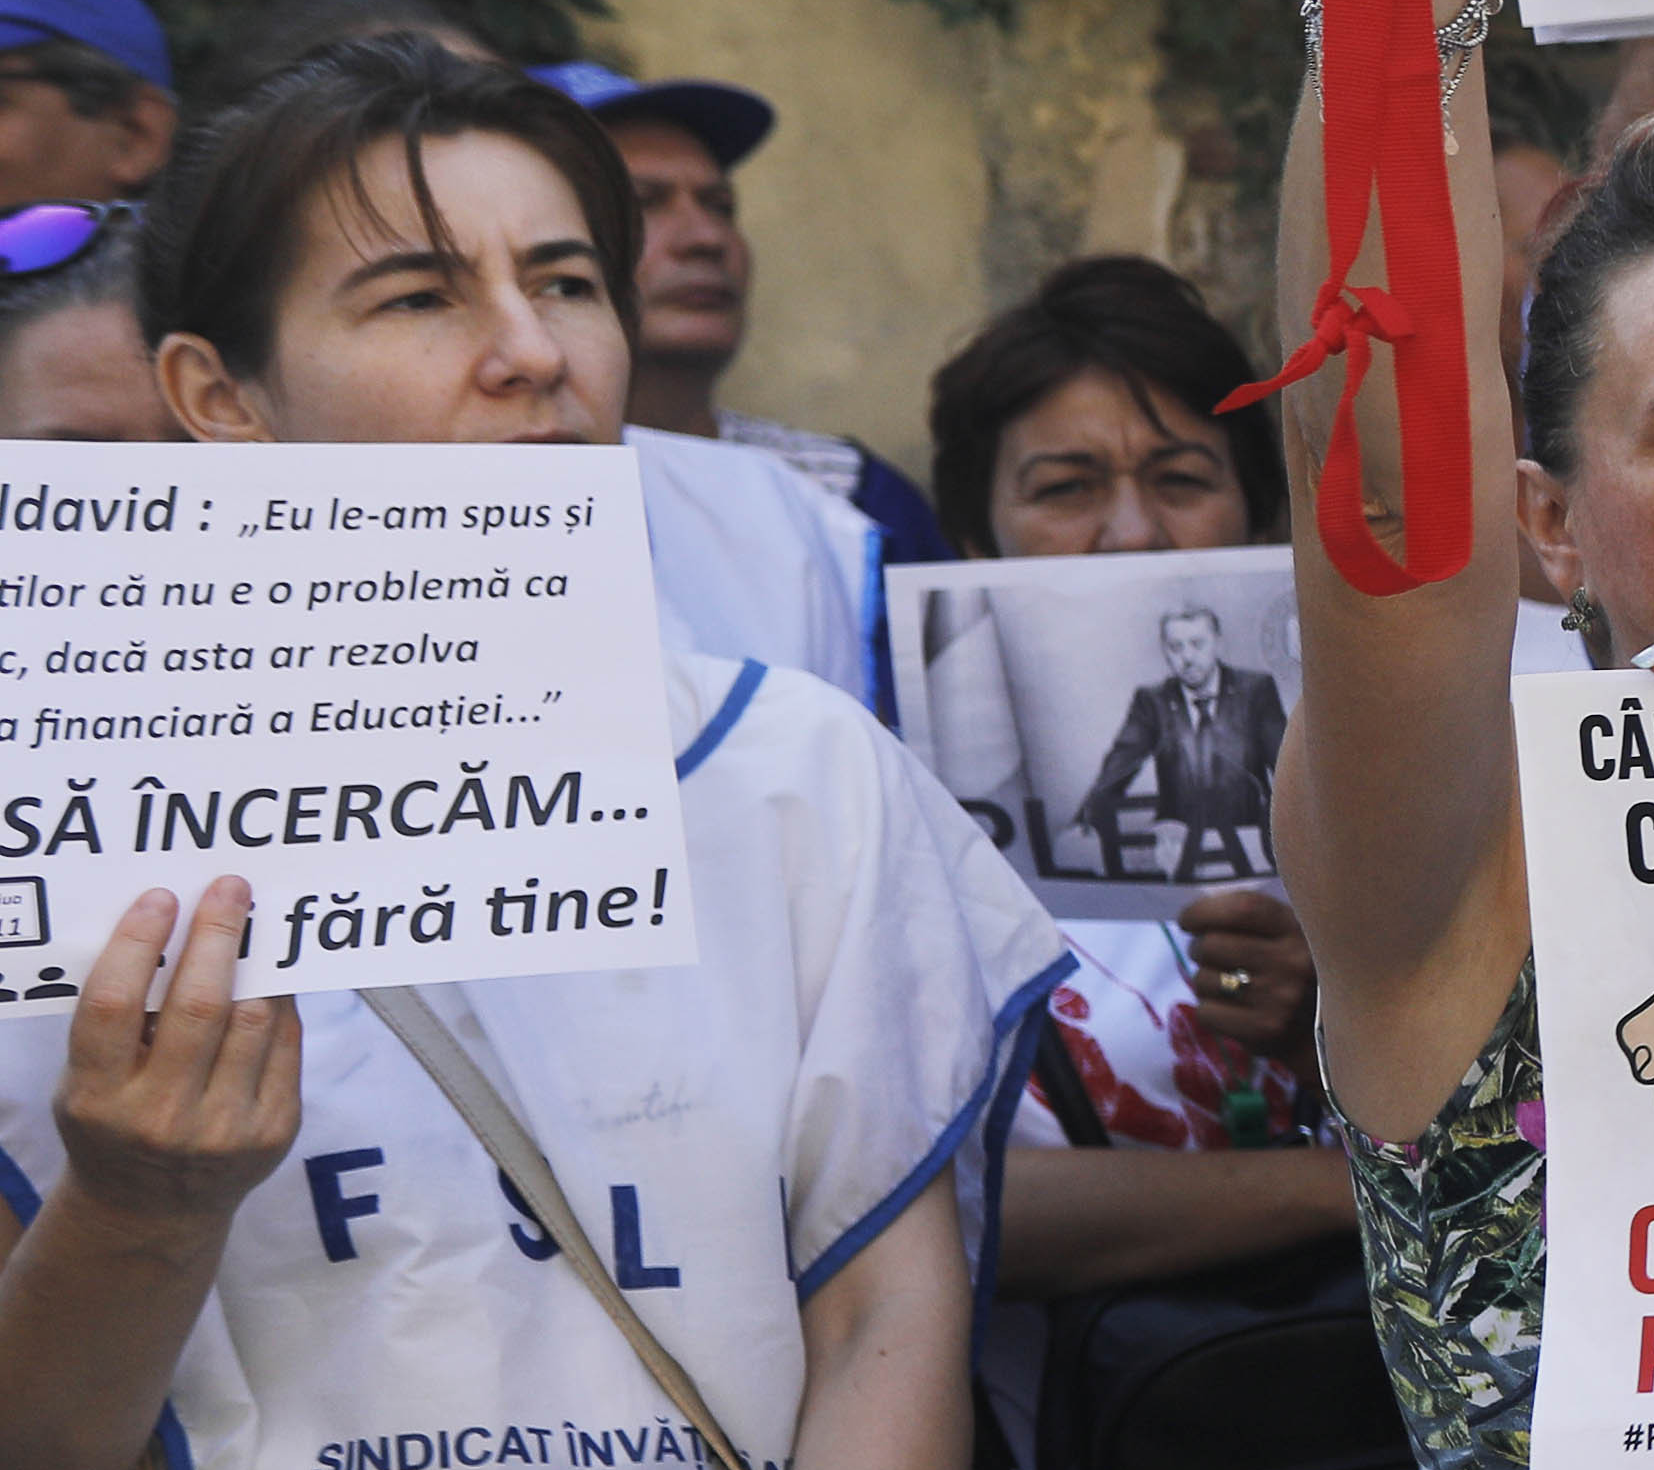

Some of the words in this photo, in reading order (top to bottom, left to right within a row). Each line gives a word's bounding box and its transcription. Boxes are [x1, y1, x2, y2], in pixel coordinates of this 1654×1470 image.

[239, 499, 313, 537] „Eu
[329, 497, 447, 531] le-am
[461, 505, 551, 536] spus
[564, 496, 594, 534] și
[99, 574, 146, 607] că
[162, 583, 215, 606] nu
[230, 582, 253, 605] e
[268, 581, 292, 605] o
[307, 567, 510, 611] problemă
[525, 575, 568, 598] ca
[45, 640, 147, 674] dacă
[163, 642, 254, 672] asta
[270, 645, 315, 669] ar
[328, 633, 479, 667] rezolva
[29, 703, 254, 750] financiară
[269, 711, 294, 734] a
[131, 760, 648, 853] ÎNCERCĂM...
[276, 883, 456, 969] fără
[485, 867, 668, 937] tine!
